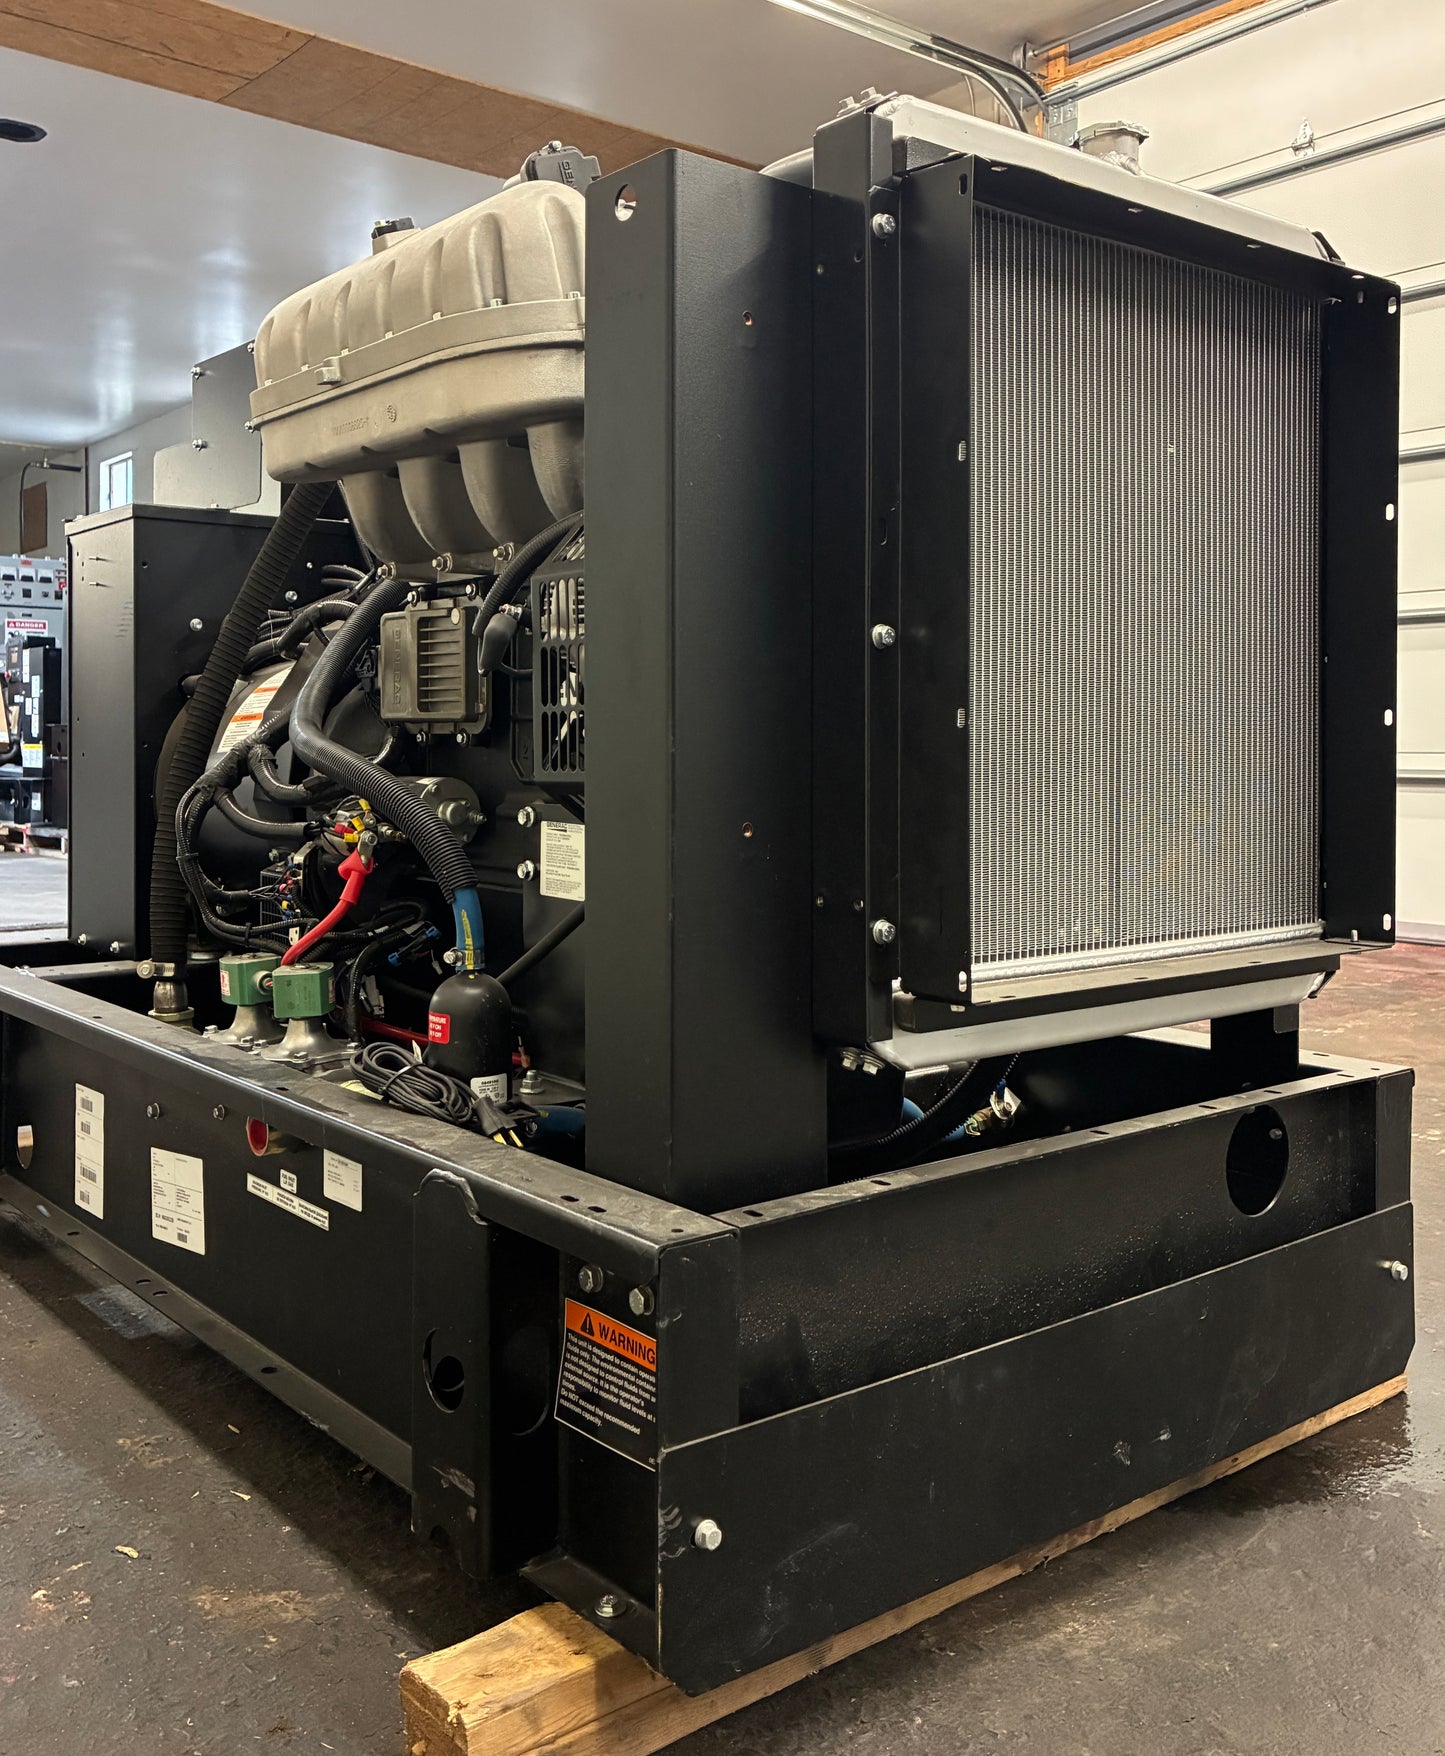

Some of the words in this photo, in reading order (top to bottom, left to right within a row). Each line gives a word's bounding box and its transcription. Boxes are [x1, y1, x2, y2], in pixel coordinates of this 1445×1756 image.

[588, 1342, 592, 1350] is
[592, 1345, 614, 1362] designed
[615, 1356, 620, 1364] to
[621, 1360, 638, 1374] contain
[599, 1322, 656, 1364] WARNING
[565, 1362, 582, 1374] external
[583, 1371, 599, 1384] source.
[605, 1382, 609, 1390] is
[610, 1385, 618, 1394] the
[619, 1389, 644, 1406] operator's
[579, 1358, 599, 1375] designed
[600, 1369, 605, 1377] to
[606, 1373, 623, 1386] control
[624, 1381, 638, 1394] fluids
[639, 1388, 650, 1400] from
[592, 1355, 600, 1365] The
[601, 1361, 635, 1381] environmental
[560, 1398, 581, 1415] maximum
[582, 1410, 603, 1427] capacity.
[561, 1388, 568, 1396] Do
[568, 1390, 579, 1402] NOT
[579, 1398, 595, 1412] exceed
[604, 1411, 641, 1435] recommended
[563, 1371, 593, 1392] responsibility
[594, 1385, 598, 1393] to
[599, 1389, 619, 1404] monitor
[619, 1398, 631, 1410] fluid
[632, 1405, 646, 1418] levels
[647, 1412, 652, 1421] at
